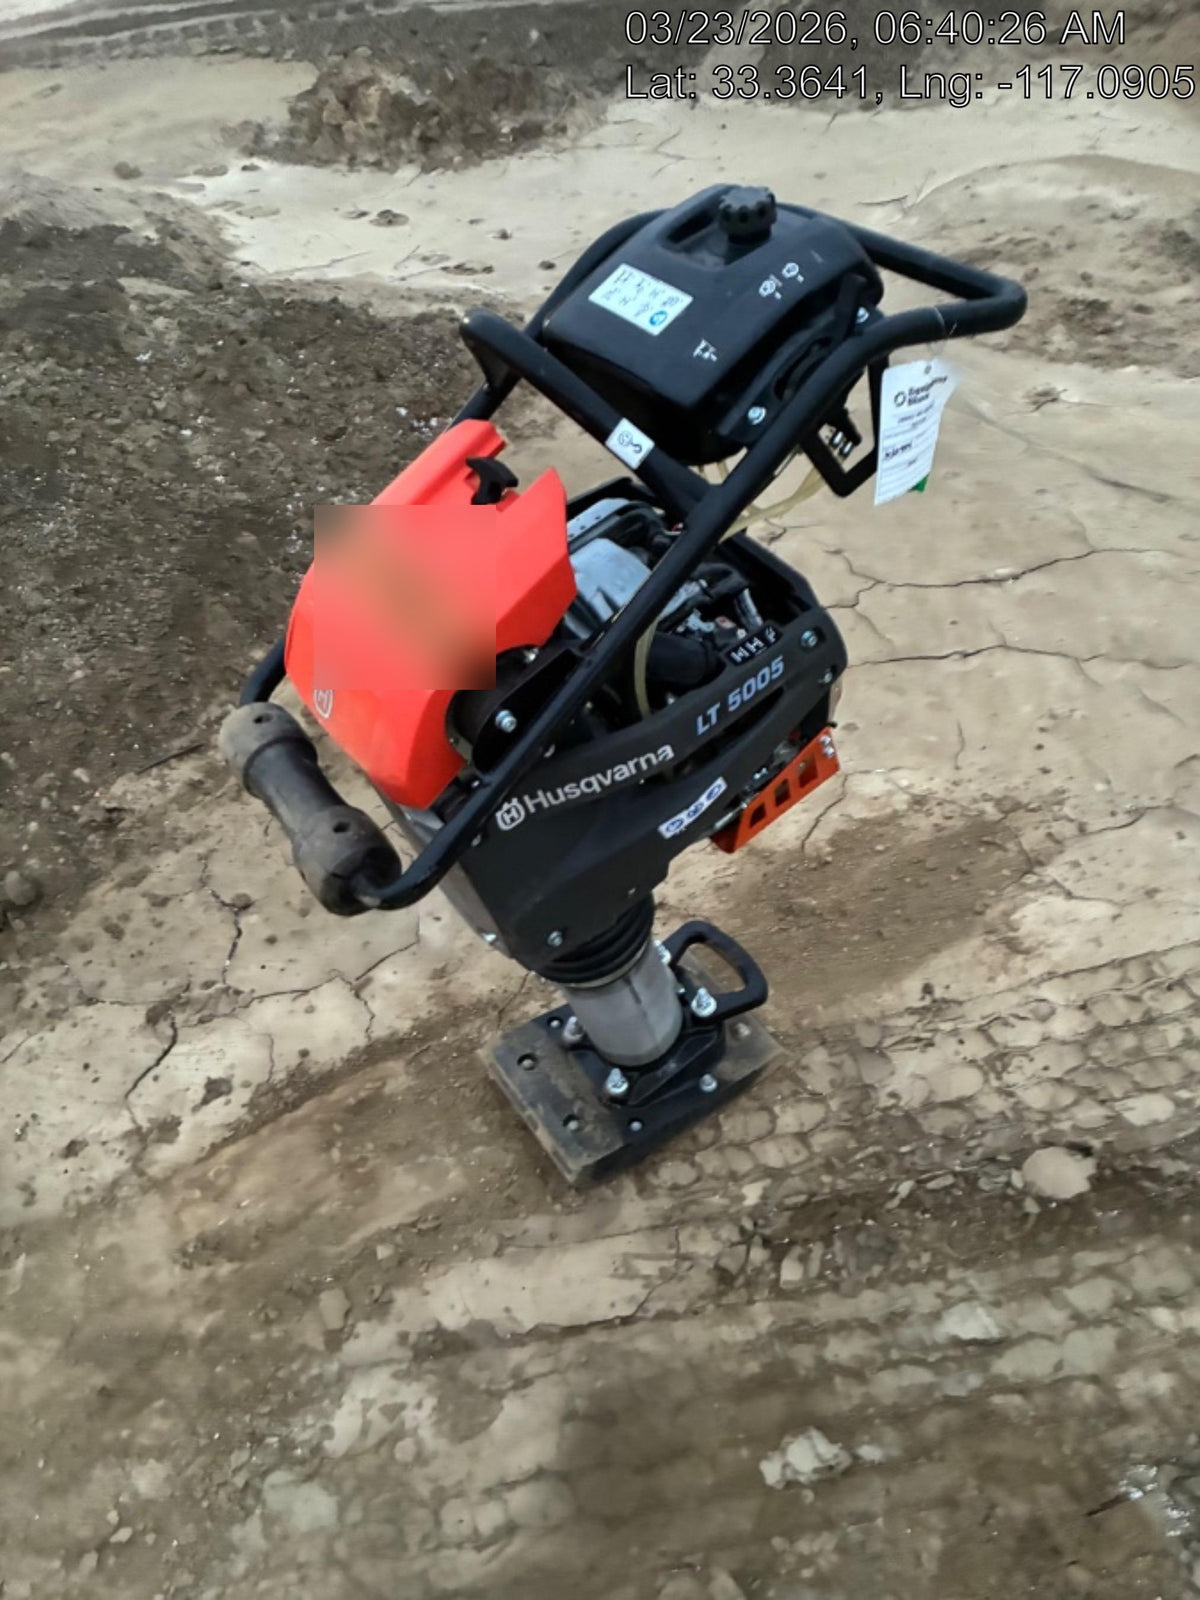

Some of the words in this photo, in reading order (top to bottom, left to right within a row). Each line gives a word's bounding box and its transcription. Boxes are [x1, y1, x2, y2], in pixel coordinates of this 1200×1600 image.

[696, 702, 721, 736] LT
[727, 655, 784, 712] 5005
[523, 744, 675, 814] Husqvarna
